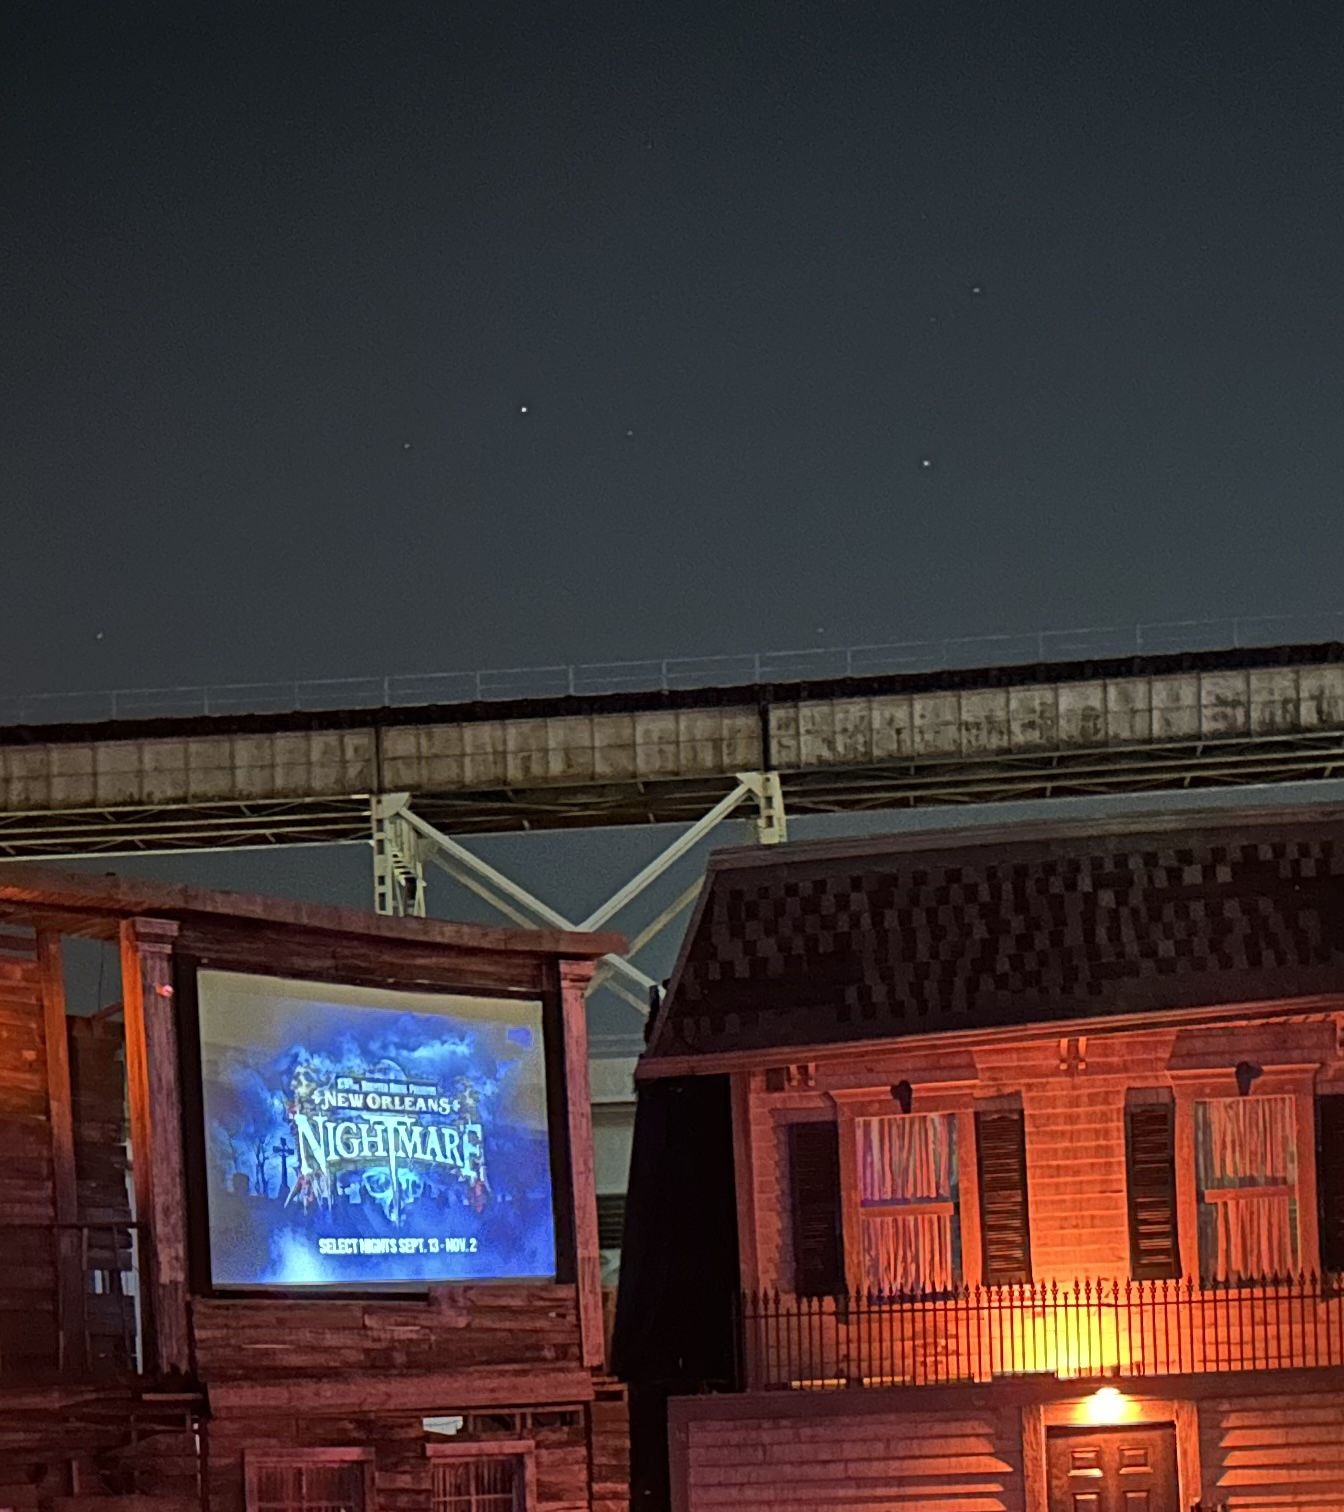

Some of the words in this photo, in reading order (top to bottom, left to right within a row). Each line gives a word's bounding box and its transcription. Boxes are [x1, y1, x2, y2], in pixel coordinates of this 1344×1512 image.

[321, 1089, 364, 1110] NEW
[365, 1093, 450, 1115] ORLEANS
[294, 1111, 482, 1194] NIGHTMARE
[318, 1238, 358, 1254] SELECT
[359, 1238, 397, 1254] NIGHTS
[398, 1238, 428, 1253] SEPT.
[469, 1238, 478, 1253] 2
